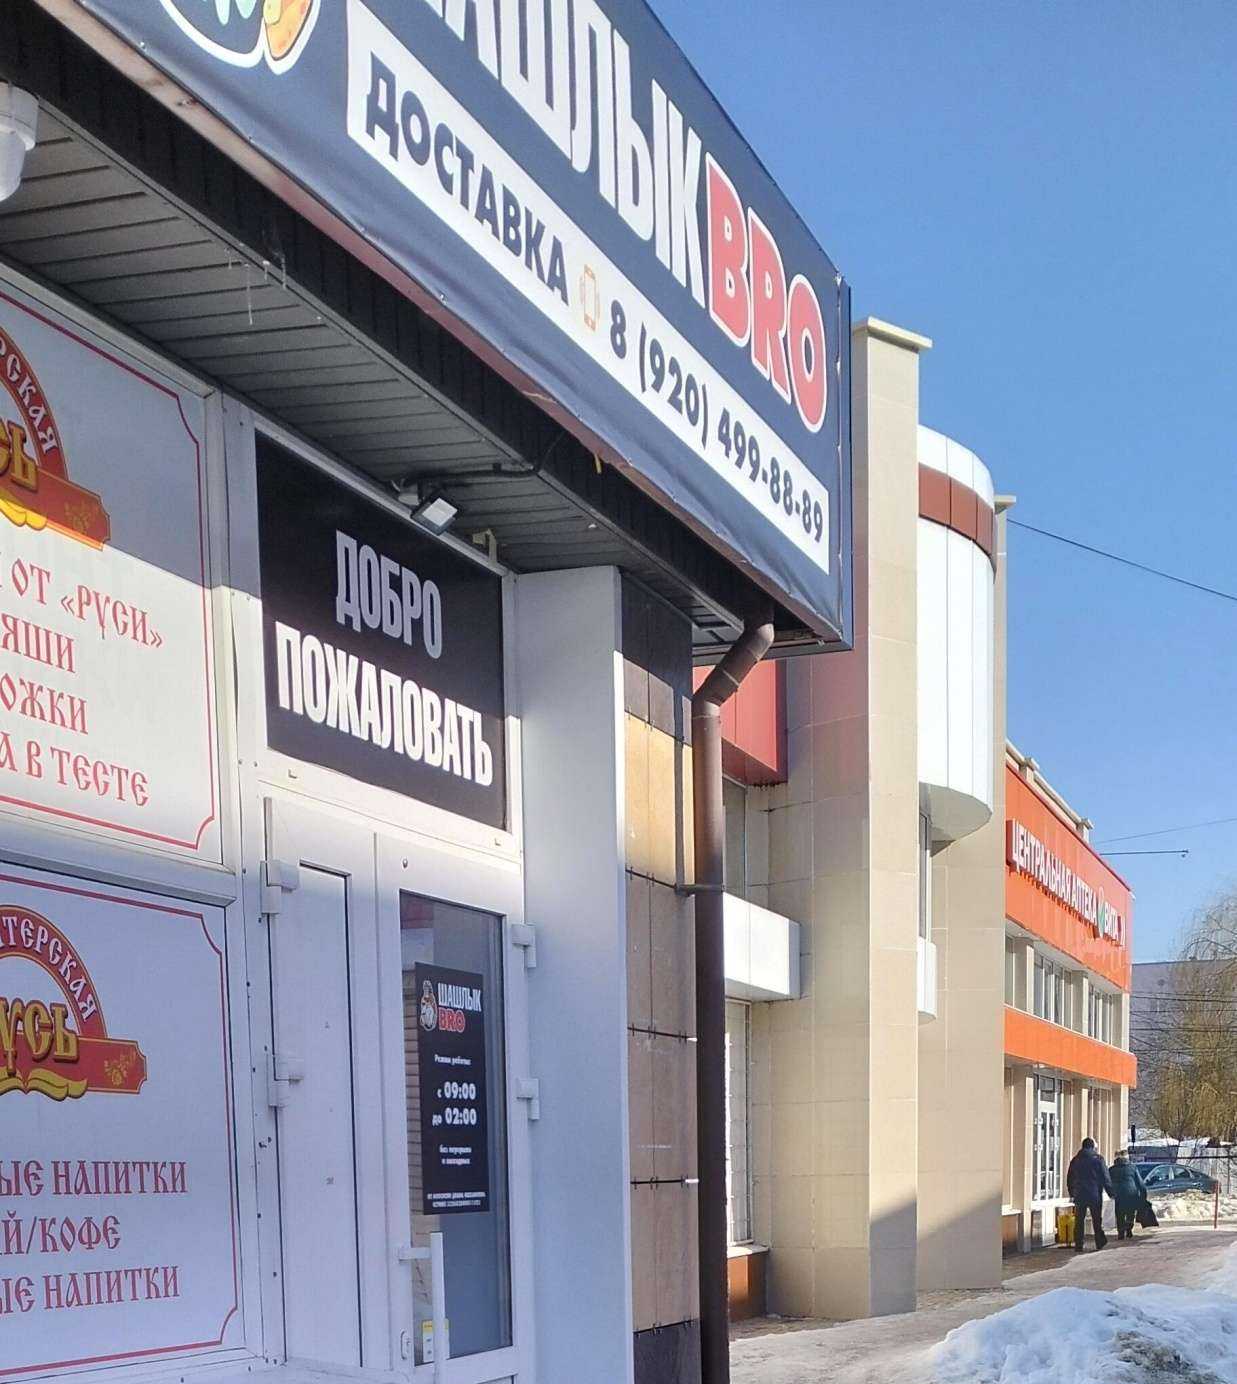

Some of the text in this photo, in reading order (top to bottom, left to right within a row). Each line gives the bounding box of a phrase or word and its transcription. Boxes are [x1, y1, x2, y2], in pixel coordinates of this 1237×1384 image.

[366, 52, 569, 306] ДОСТАВКА
[610, 300, 627, 359] 8
[706, 152, 827, 433] BRO
[639, 321, 709, 450] (920)
[718, 407, 824, 543] 499-88-89
[12, 558, 163, 649] ОТ «РУСИ»
[336, 530, 442, 660] ДОБРО
[275, 621, 493, 787] ПОЖАЛОВАТЬ
[26, 740, 42, 779] В
[50, 746, 149, 807] ТЕСТЕ
[1012, 818, 1072, 903] ЦЕНТРАЛЬНАЯ
[0, 916, 97, 1022] ТЕРСКАЯ
[438, 982, 482, 1012] ШАШЛЫК
[438, 1006, 466, 1033] BRO
[444, 1081, 476, 1100] 09:00
[445, 1107, 477, 1125] 02:00
[51, 1160, 188, 1195] НАПИТКИ
[42, 1266, 180, 1310] НАПИТКИ
